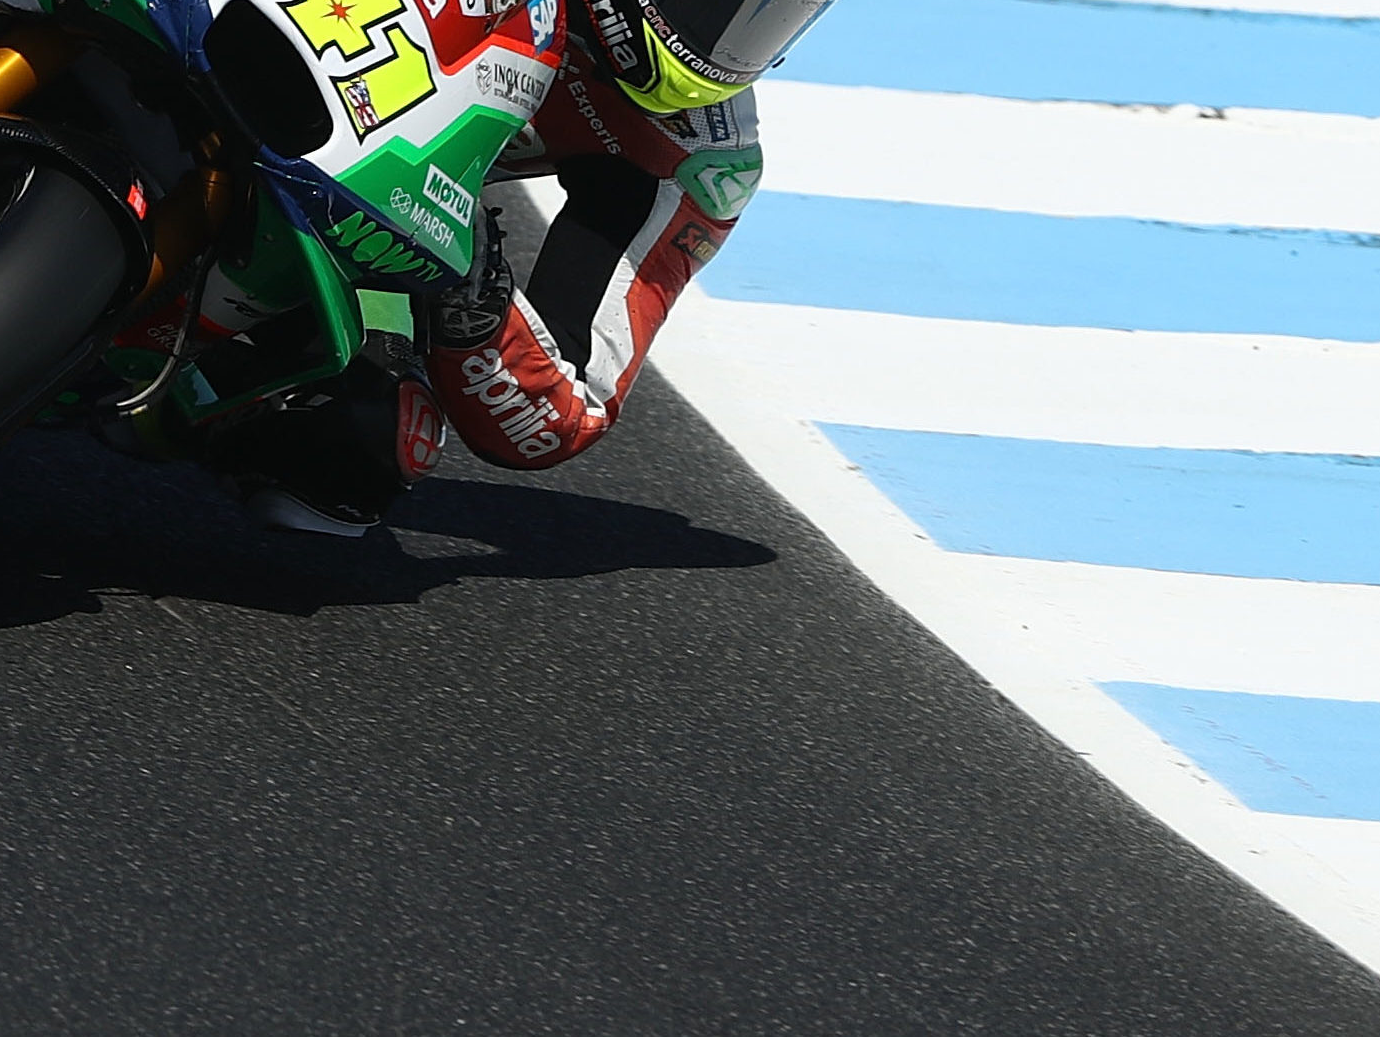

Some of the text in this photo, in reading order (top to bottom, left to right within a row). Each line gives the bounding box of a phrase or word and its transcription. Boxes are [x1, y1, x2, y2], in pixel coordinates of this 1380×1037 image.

[568, 79, 621, 156] Experis
[410, 202, 454, 249] MARSH
[426, 171, 474, 224] MOTUL
[325, 210, 422, 274] NOW
[461, 347, 562, 460] aprilia
